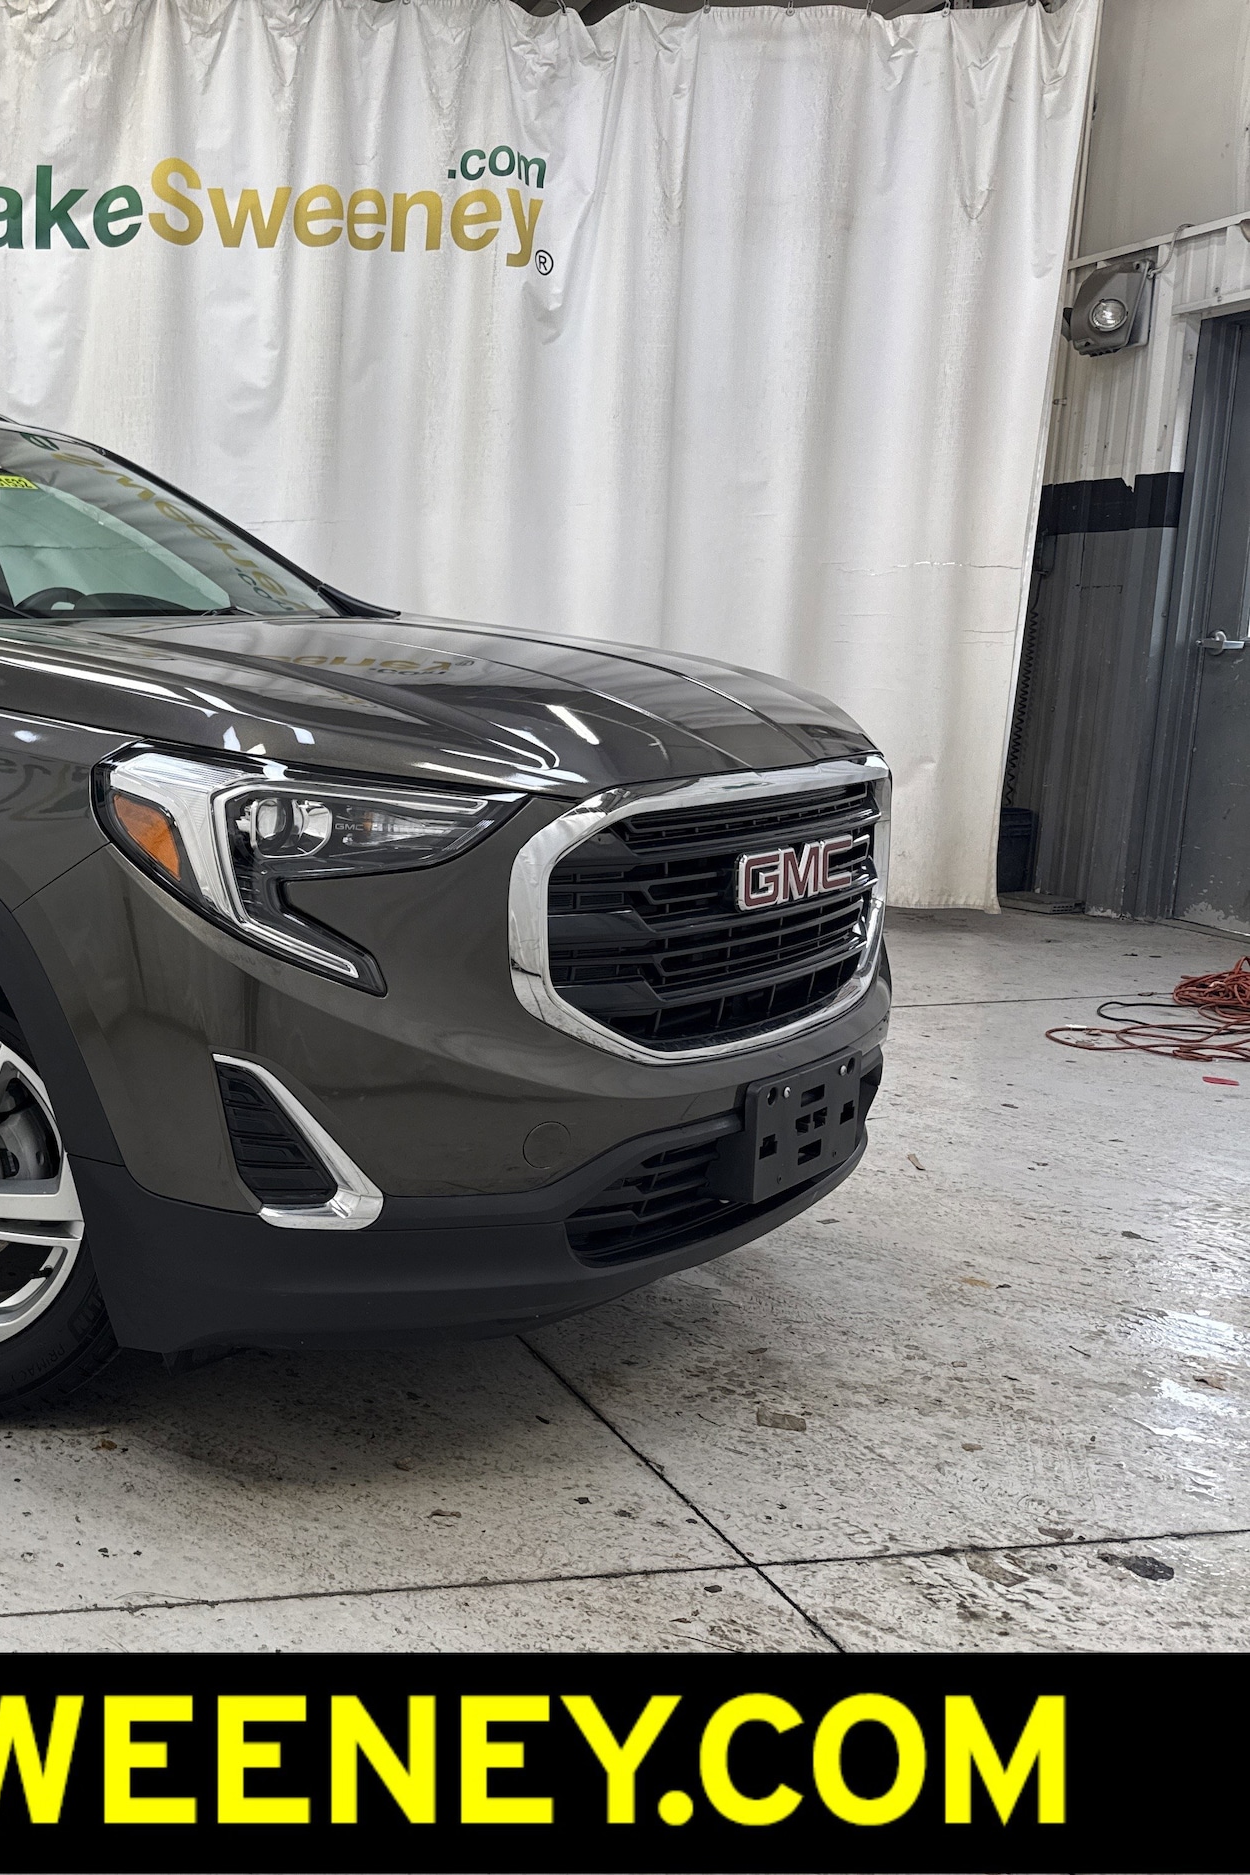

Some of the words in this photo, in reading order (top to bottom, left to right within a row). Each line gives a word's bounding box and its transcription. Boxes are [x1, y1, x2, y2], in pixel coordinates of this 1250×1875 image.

[448, 145, 547, 189] .com
[334, 822, 364, 831] GMC
[737, 834, 853, 911] GMC
